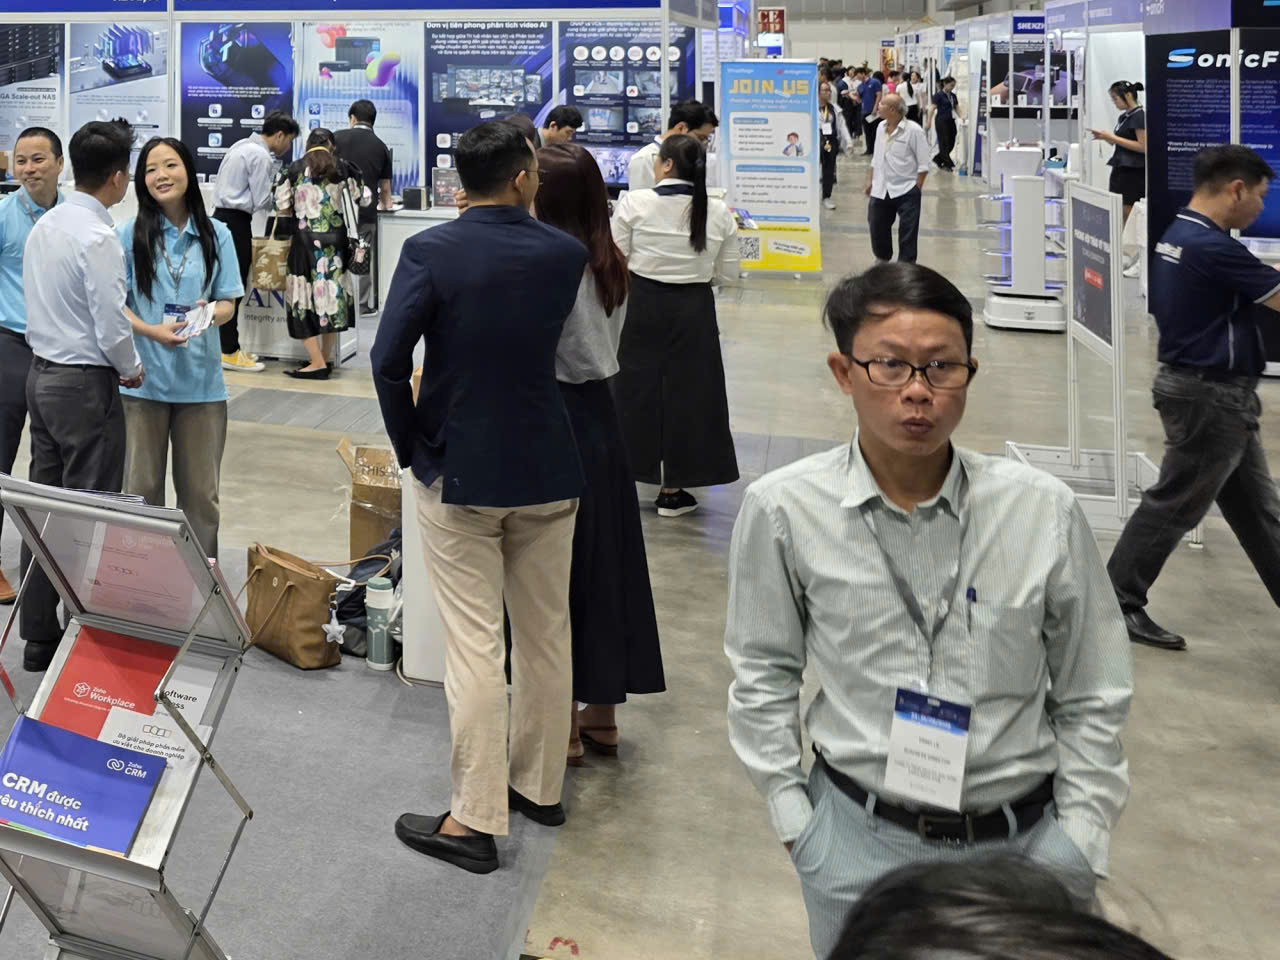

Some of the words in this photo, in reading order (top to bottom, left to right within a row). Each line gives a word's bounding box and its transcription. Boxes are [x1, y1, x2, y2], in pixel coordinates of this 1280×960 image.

[464, 22, 485, 30] phong
[729, 79, 774, 95] JOIN
[783, 80, 809, 95] US
[92, 686, 107, 694] Zoho
[89, 692, 135, 709] Workplace
[121, 740, 132, 750] việt
[145, 746, 164, 756] doanh
[165, 750, 185, 761] nghiệp
[138, 738, 154, 749] pháp
[155, 742, 170, 751] phần
[171, 744, 186, 753] mềm
[125, 766, 147, 779] CRM
[128, 761, 142, 769] Zoho
[2, 772, 48, 798] CRM
[46, 791, 82, 811] được
[19, 801, 54, 821] thích
[55, 814, 89, 832] nhất
